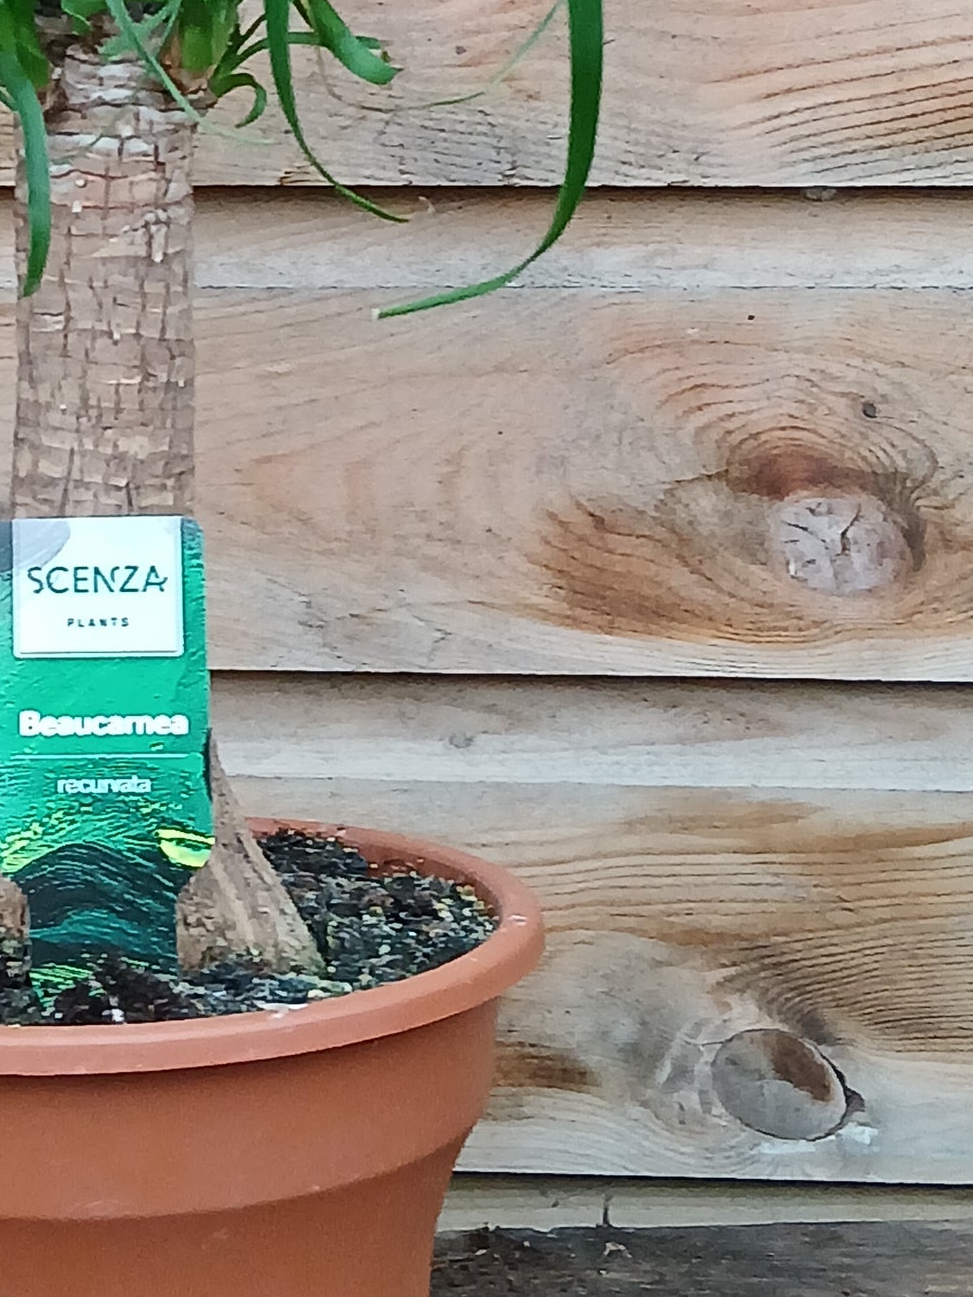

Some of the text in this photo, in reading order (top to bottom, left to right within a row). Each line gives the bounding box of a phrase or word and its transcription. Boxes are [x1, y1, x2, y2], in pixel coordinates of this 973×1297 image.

[27, 565, 168, 594] SCENZA
[67, 617, 129, 628] PLANTS
[18, 710, 189, 737] Beaucarnea
